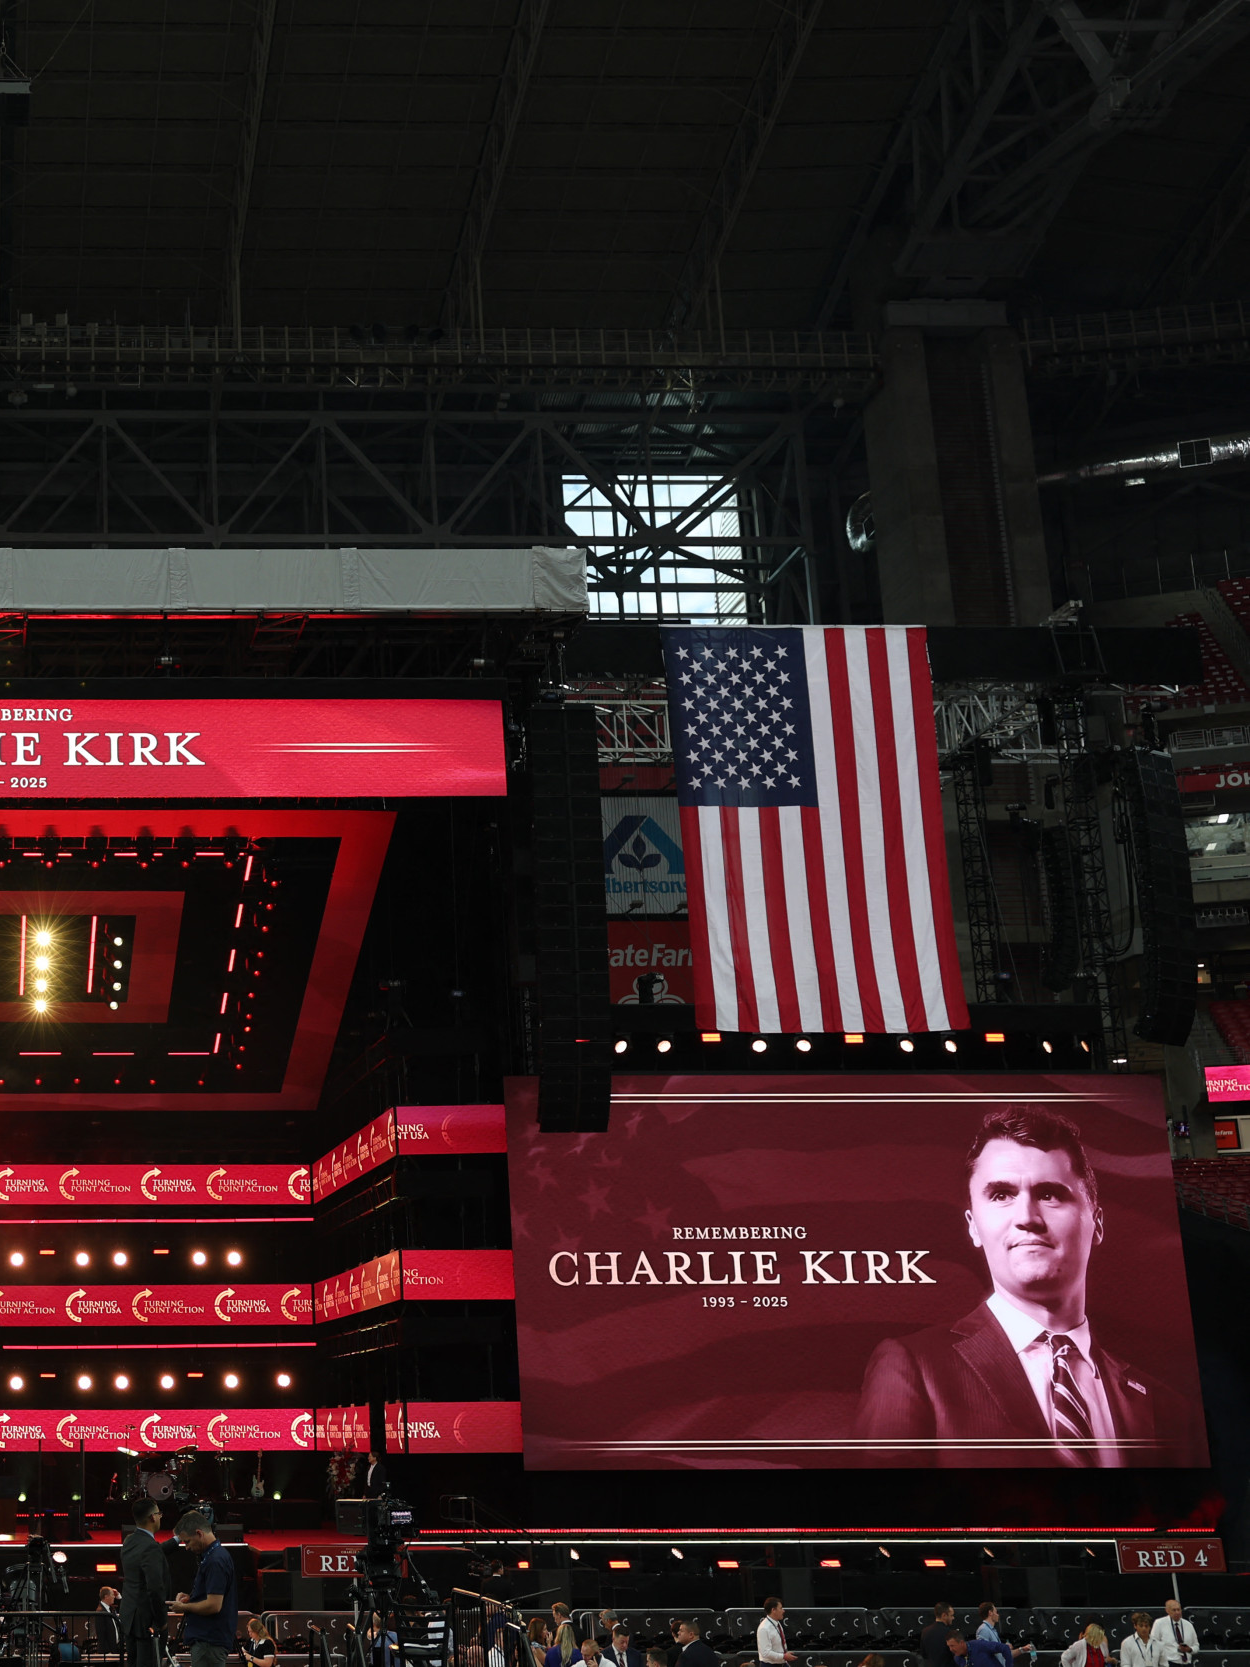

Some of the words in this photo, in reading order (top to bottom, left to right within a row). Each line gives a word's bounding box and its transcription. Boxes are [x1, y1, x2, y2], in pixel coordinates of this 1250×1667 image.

[62, 731, 206, 766] KIRK
[10, 777, 48, 788] 2025
[605, 877, 687, 894] lbertson
[608, 943, 693, 967] ateFar
[1206, 1079, 1238, 1087] RNING
[397, 1124, 424, 1132] NING
[410, 1131, 429, 1140] USA
[672, 1226, 807, 1240] REMEMBERING
[549, 1251, 781, 1287] CHARLIE
[799, 1250, 937, 1285] KIRK
[405, 1276, 444, 1285] ACTION
[702, 1296, 735, 1308] 1993
[752, 1296, 788, 1308] 2025
[226, 1305, 254, 1313] POINT
[254, 1305, 271, 1313] USA
[407, 1422, 435, 1430] NING
[152, 1431, 180, 1439] POINT
[180, 1431, 197, 1439] USA
[420, 1429, 441, 1438] USA
[1135, 1550, 1185, 1568] RED
[1194, 1549, 1208, 1567] 4
